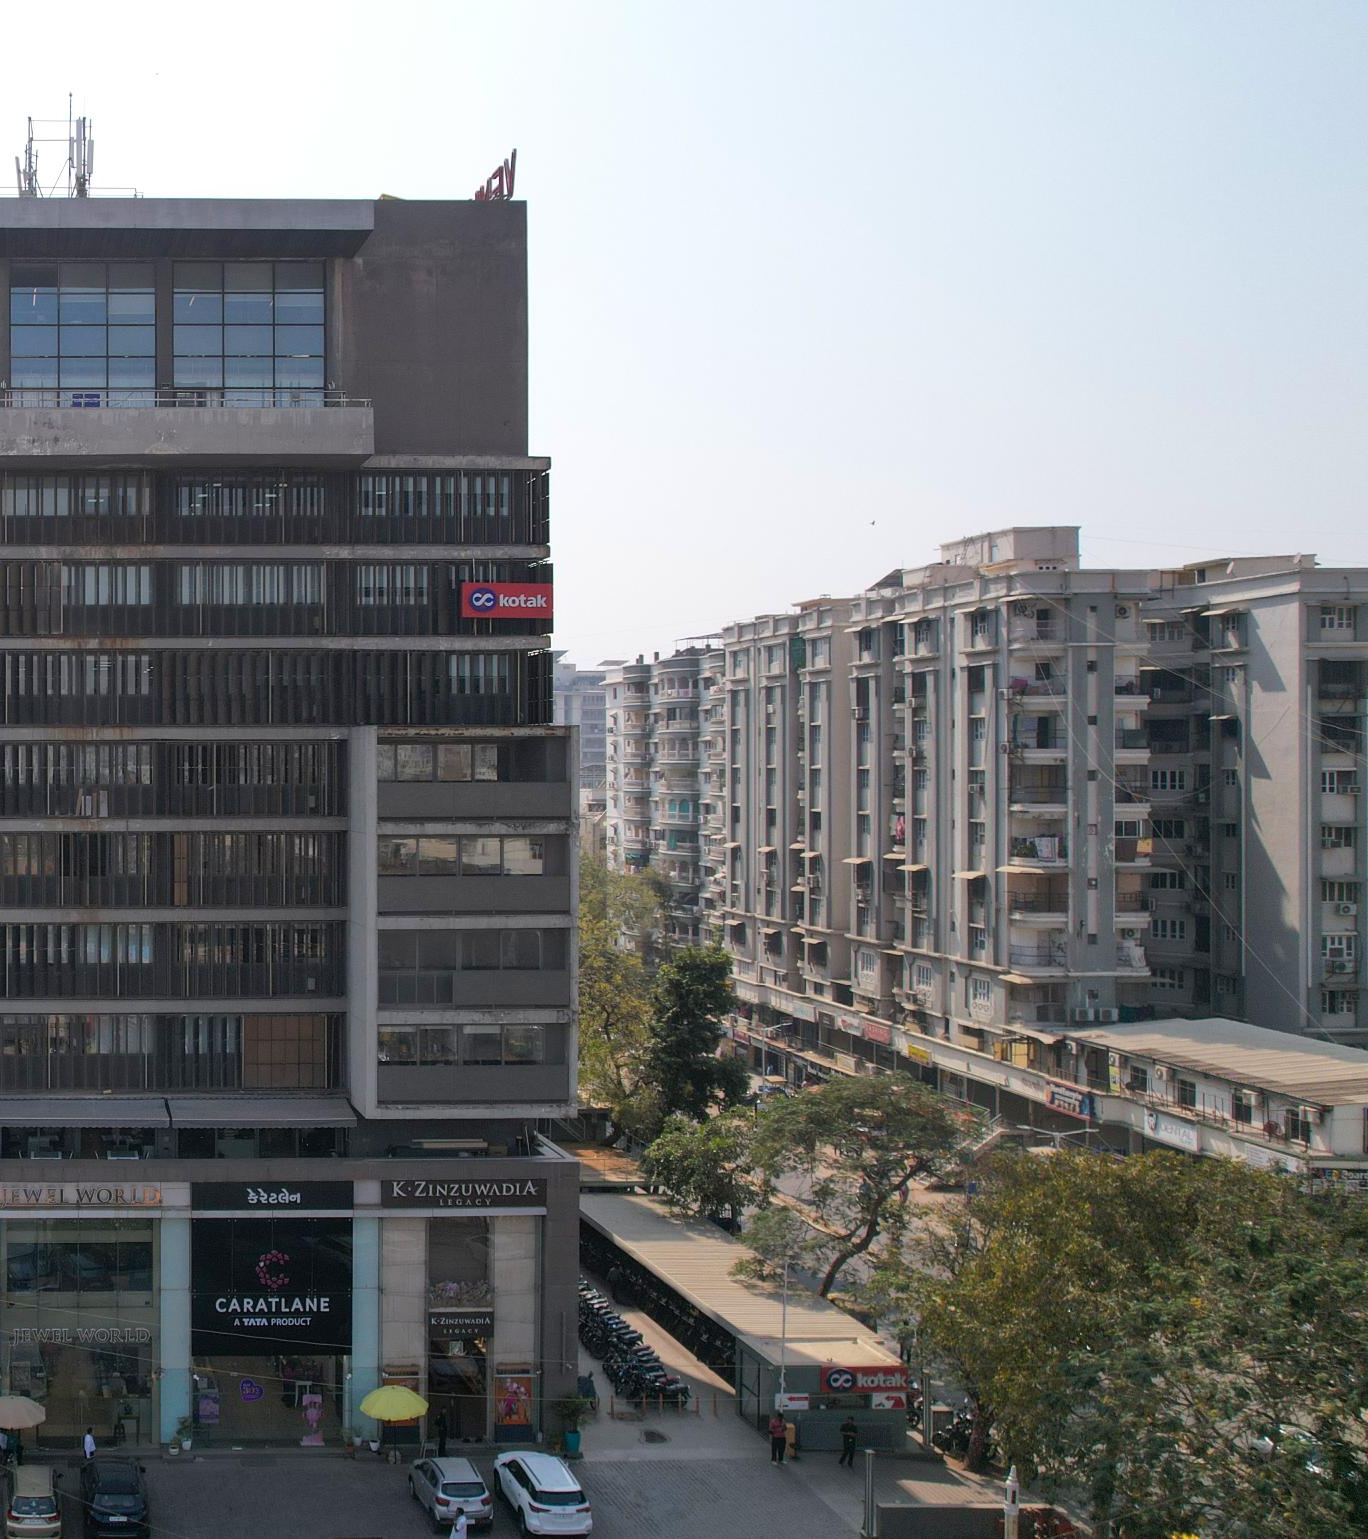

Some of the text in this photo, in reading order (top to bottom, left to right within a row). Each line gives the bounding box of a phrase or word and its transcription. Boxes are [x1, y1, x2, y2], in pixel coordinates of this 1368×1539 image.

[499, 594, 547, 608] kotak
[215, 1298, 330, 1312] CARATLANE
[234, 1317, 312, 1326] A TATA PRODUCT
[9, 1327, 152, 1347] JEWEL WORLD
[856, 1371, 906, 1388] kotak
